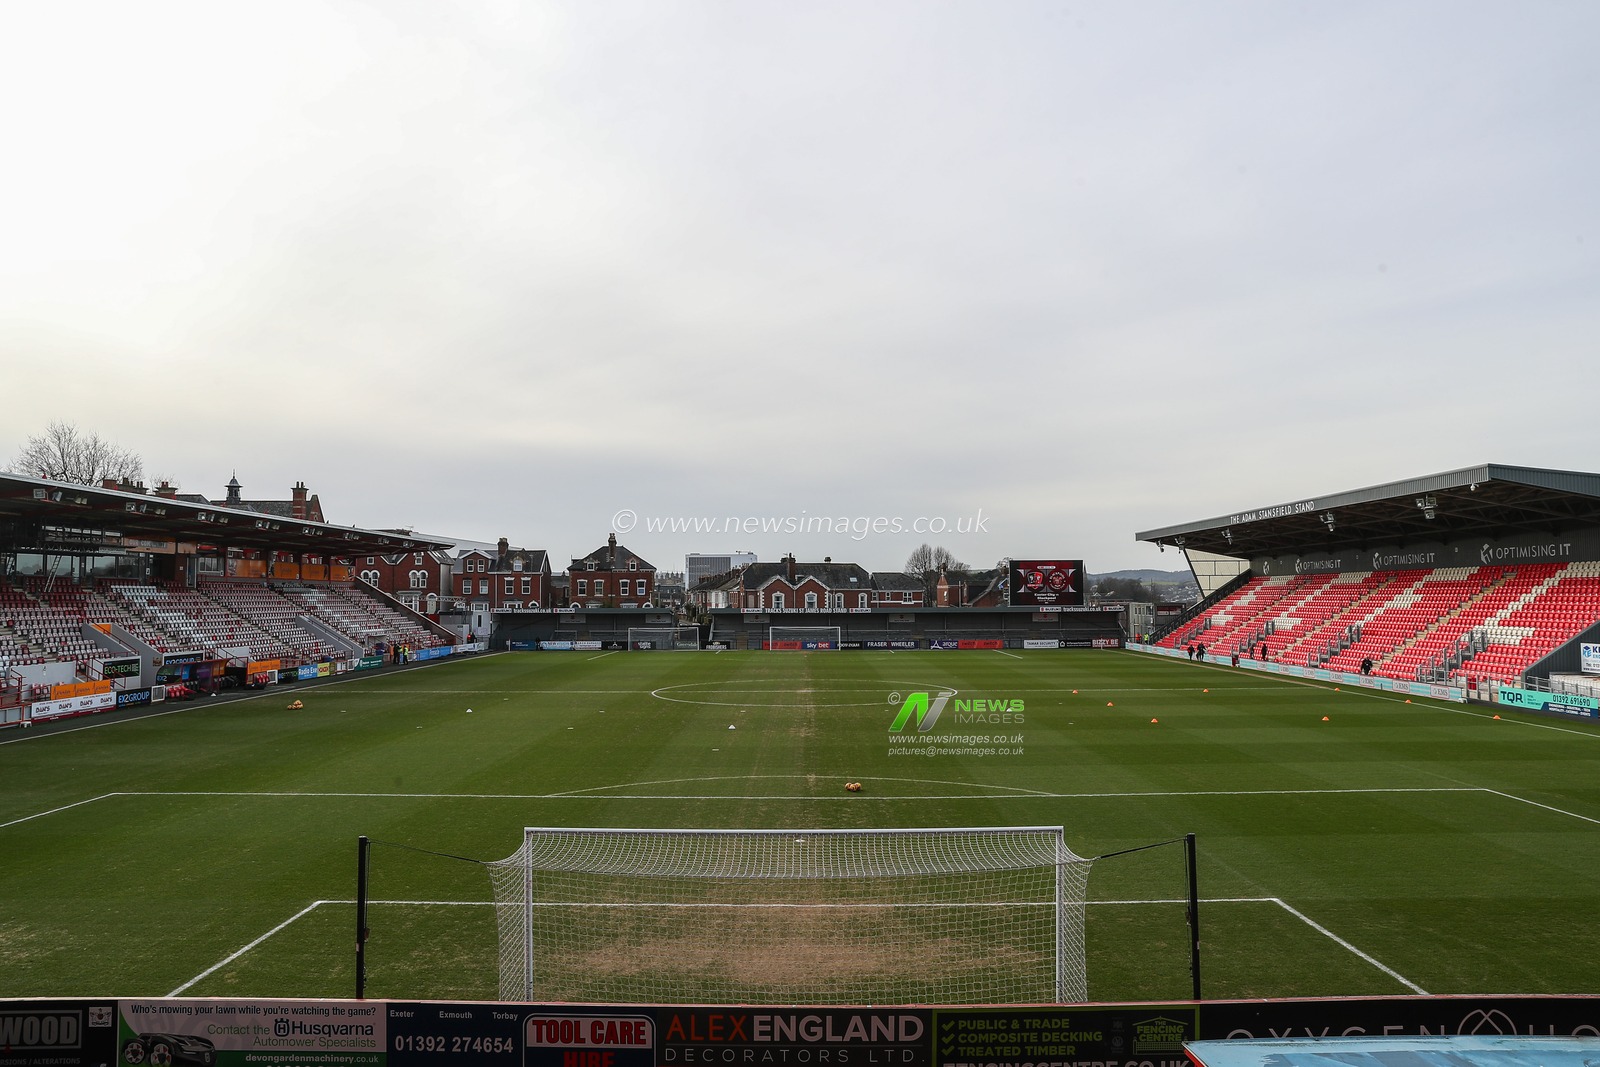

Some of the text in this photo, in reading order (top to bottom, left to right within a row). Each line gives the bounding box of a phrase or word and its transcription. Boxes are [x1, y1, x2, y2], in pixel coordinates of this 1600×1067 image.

[1230, 501, 1315, 525] THE ADAM STANSFIELD STAND
[1496, 543, 1571, 559] OPTIMISING IT
[1303, 559, 1341, 571] OPTIMISING IT
[1384, 552, 1435, 566] OPTIMISING IT
[1398, 682, 1409, 690] EMS
[1435, 688, 1448, 696] EMS
[118, 690, 151, 704] EX2GROUP
[1500, 691, 1523, 704] TQR
[131, 1004, 376, 1017] Who's mowing your lawn while you're watching the game?
[389, 1010, 415, 1018] Exeter
[439, 1011, 472, 1019] Exmouth
[492, 1012, 518, 1021] Torbay
[207, 1024, 250, 1035] Contact
[253, 1025, 270, 1035] the
[291, 1021, 375, 1037] Husqvarna
[666, 1014, 924, 1042] ALEX ENGLAND
[958, 1019, 1070, 1030] PUBLIC & TRADE
[1137, 1025, 1185, 1034] FENCING
[532, 1020, 647, 1045] TOOL CARE
[958, 1031, 1103, 1043] COMPOSITE DECKING
[1138, 1033, 1182, 1042] CENTRE
[253, 1036, 377, 1048] Automower Specialists
[395, 1035, 514, 1053] 01392 274654
[665, 1049, 925, 1062] DECORATORS LTD.
[958, 1045, 1076, 1057] TREATED TIMBER
[245, 1054, 379, 1064] devongardenmachinery.co.uk
